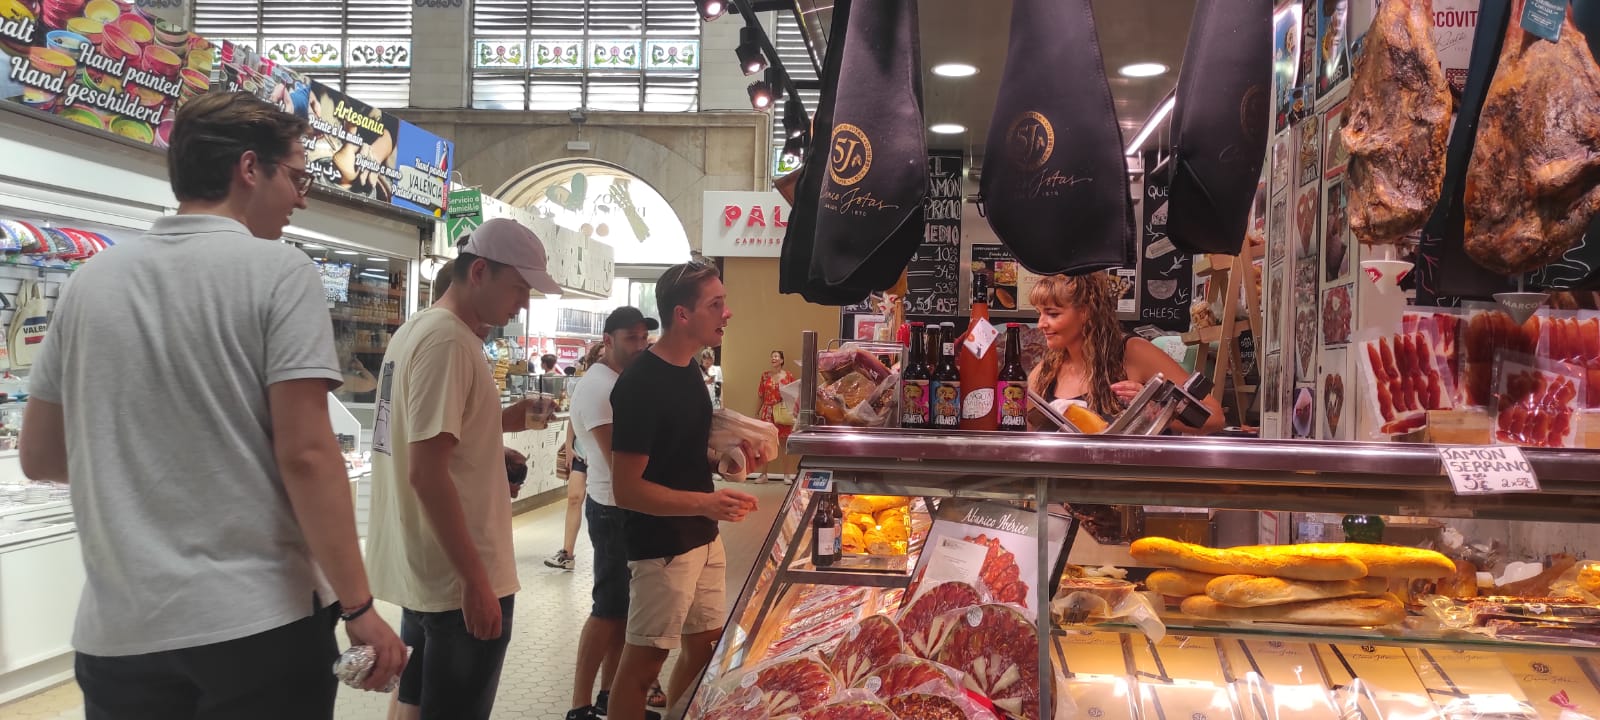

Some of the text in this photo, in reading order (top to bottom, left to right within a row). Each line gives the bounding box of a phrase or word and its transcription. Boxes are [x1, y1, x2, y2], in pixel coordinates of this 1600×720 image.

[0, 17, 36, 43] alt
[80, 42, 183, 98] Hand painted
[11, 56, 164, 125] Hand geschilderd
[309, 114, 331, 133] Peinte
[346, 133, 363, 146] main
[386, 168, 402, 180] mano
[410, 173, 442, 199] VALENCIA
[447, 202, 480, 214] domicilio
[1143, 307, 1181, 320] CHEESE
[1451, 461, 1530, 473] SERRANO
[963, 507, 1029, 535] Abanico Ibérico
